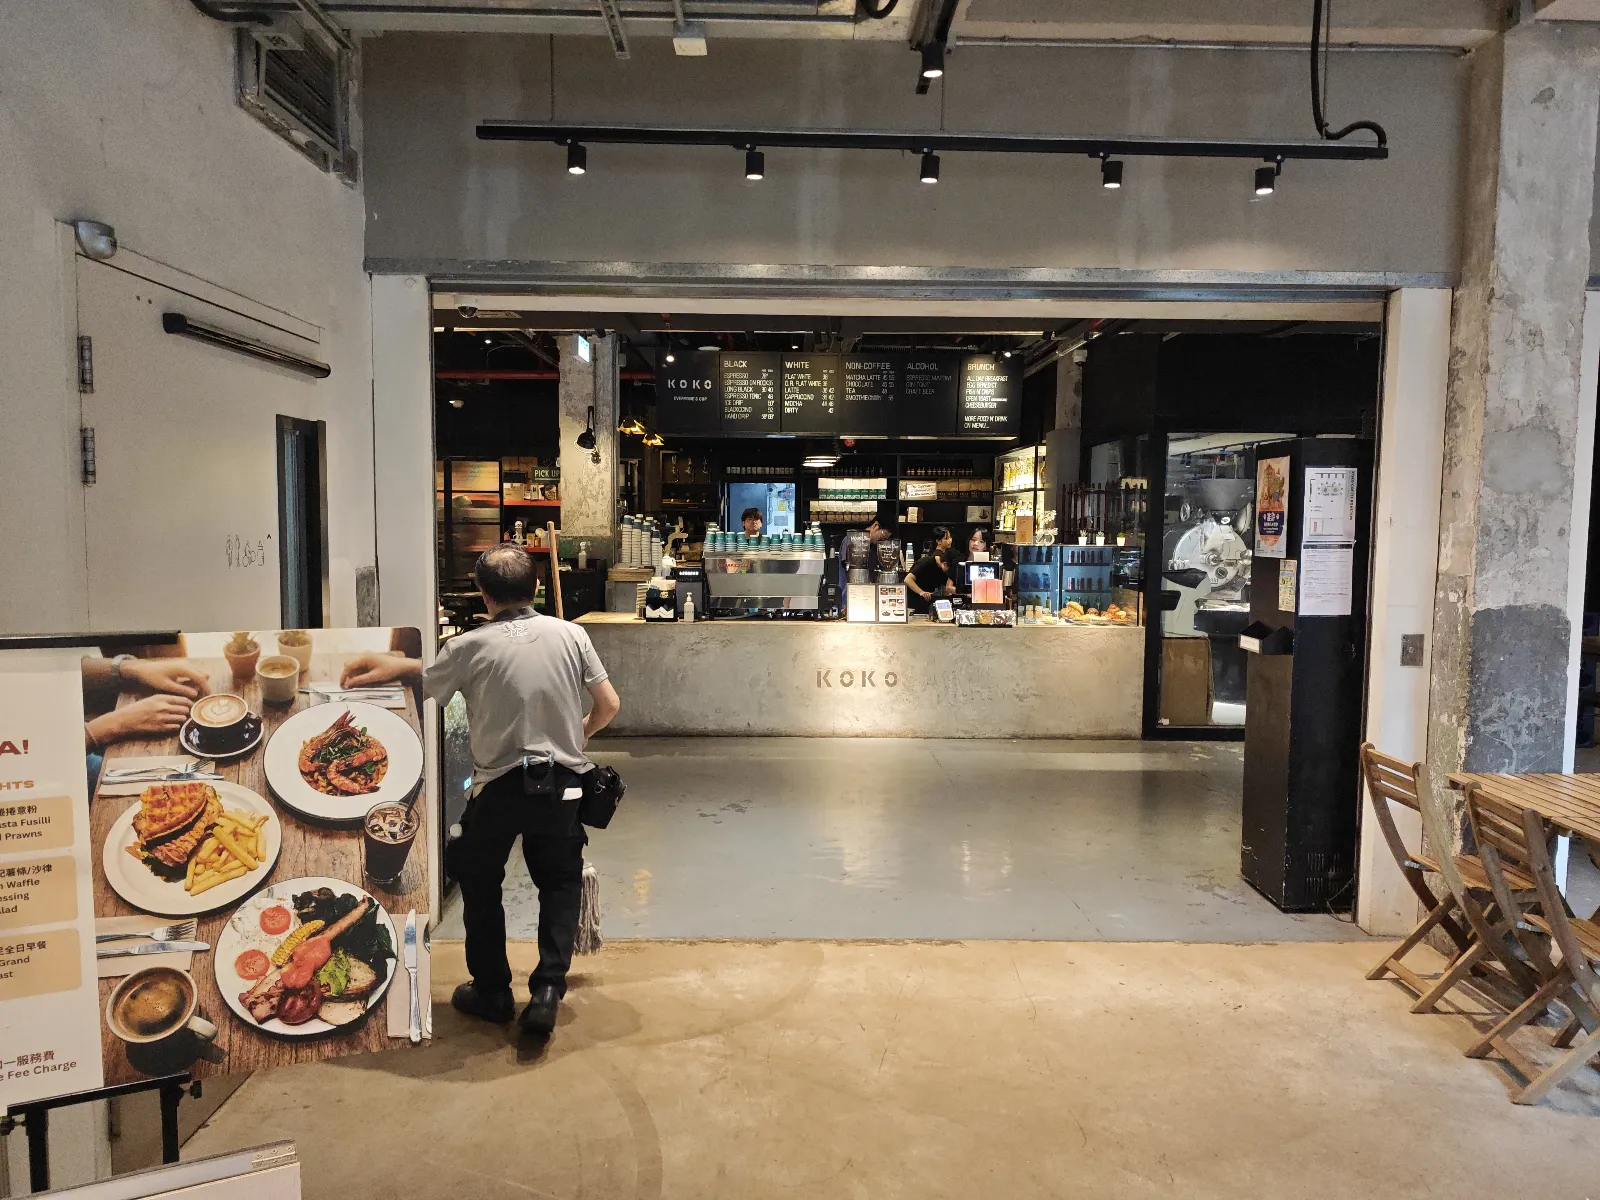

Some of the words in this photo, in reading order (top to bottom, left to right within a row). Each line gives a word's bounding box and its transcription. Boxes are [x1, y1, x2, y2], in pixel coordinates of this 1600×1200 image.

[668, 379, 711, 389] KOKO
[816, 669, 898, 688] KOKO
[0, 739, 28, 756] A!
[0, 780, 35, 790] HTS
[21, 816, 51, 826] Fusilli
[5, 831, 43, 840] Prawns
[6, 878, 40, 888] Waffle
[0, 905, 18, 914] lad
[0, 955, 30, 967] Grand
[0, 1050, 55, 1069] 一服務費
[8, 1069, 30, 1080] Fee
[33, 1061, 77, 1075] Charge
